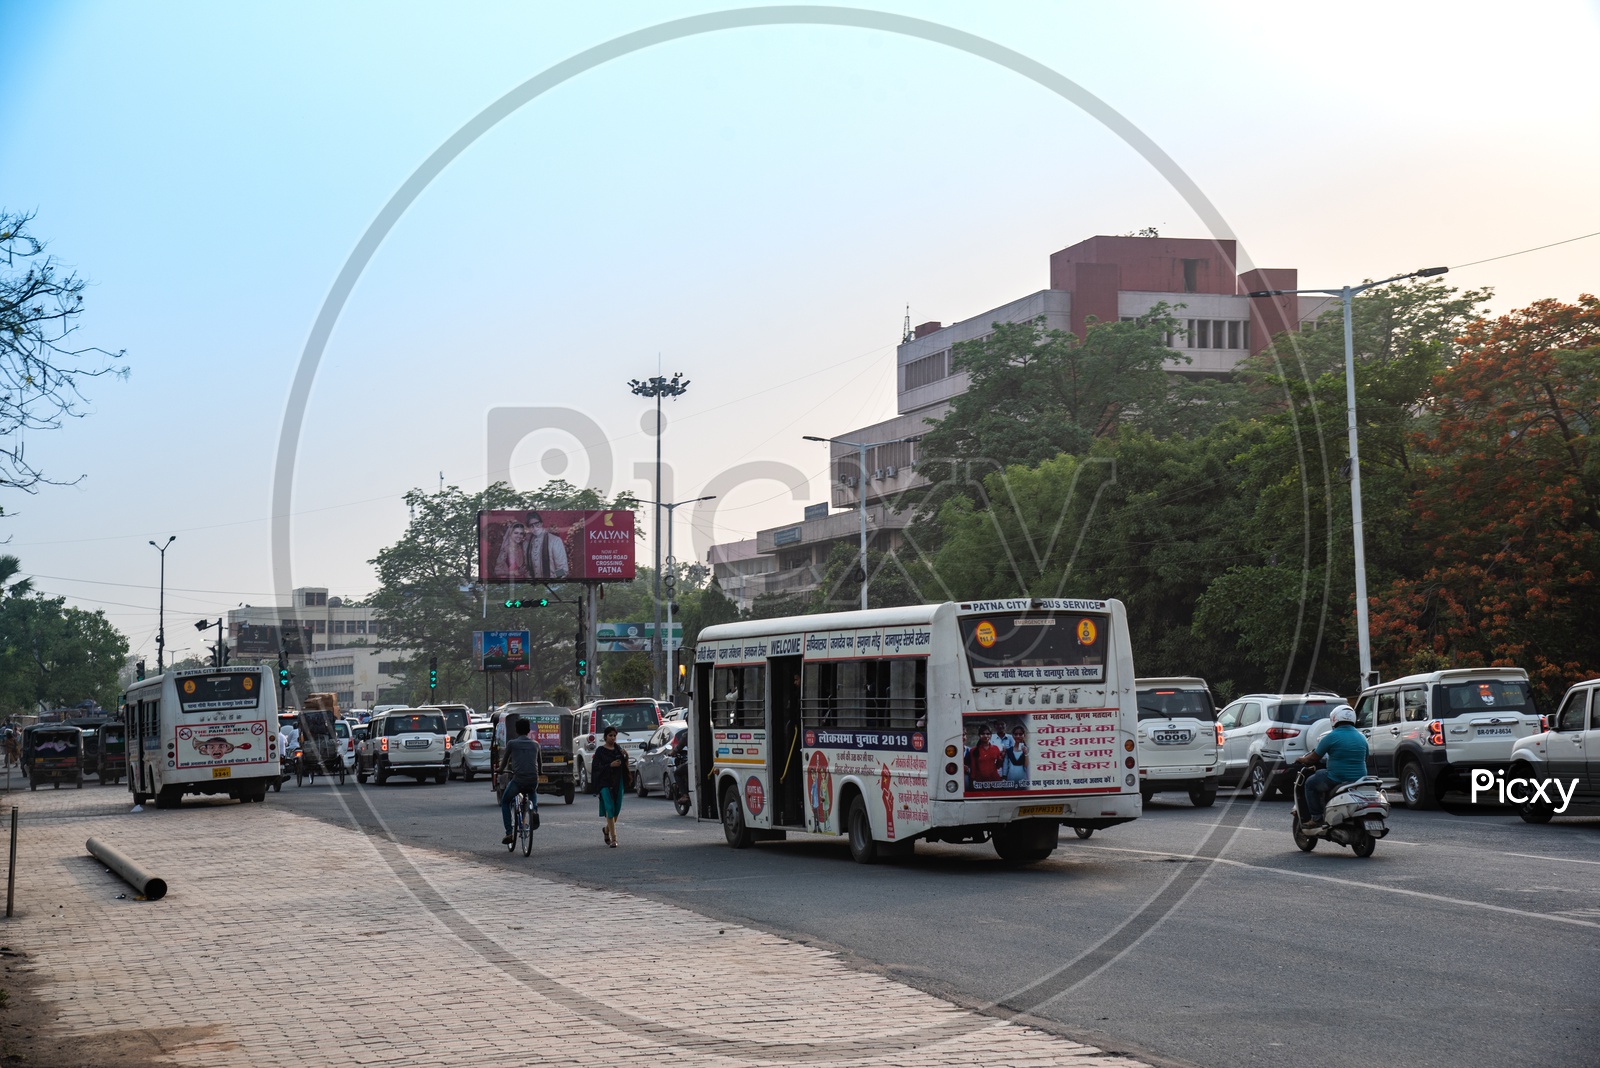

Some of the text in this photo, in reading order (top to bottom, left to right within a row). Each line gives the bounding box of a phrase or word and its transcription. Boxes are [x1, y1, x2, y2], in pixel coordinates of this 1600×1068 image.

[590, 531, 629, 540] KALYAN
[973, 600, 1100, 611] PATNA CITY BUS SERVICE
[885, 629, 930, 652] दानापुर रेलवे स्टेशन
[771, 638, 801, 655] WELCOME
[984, 669, 999, 679] पटना
[1018, 668, 1034, 678] मैदान
[1036, 668, 1041, 677] से
[1044, 668, 1064, 679] दानापुर
[1066, 667, 1079, 677] रेलवे
[1081, 667, 1098, 676] स्टेशन
[1076, 712, 1090, 721] सुगम
[1037, 723, 1115, 734] लोकतंत्र का
[818, 731, 908, 747] लोकसभा चुनाव 2019
[1037, 736, 1116, 747] यही आधार
[1084, 749, 1113, 758] जाए
[1037, 760, 1067, 772] कोई
[1071, 761, 1111, 770] बेकार
